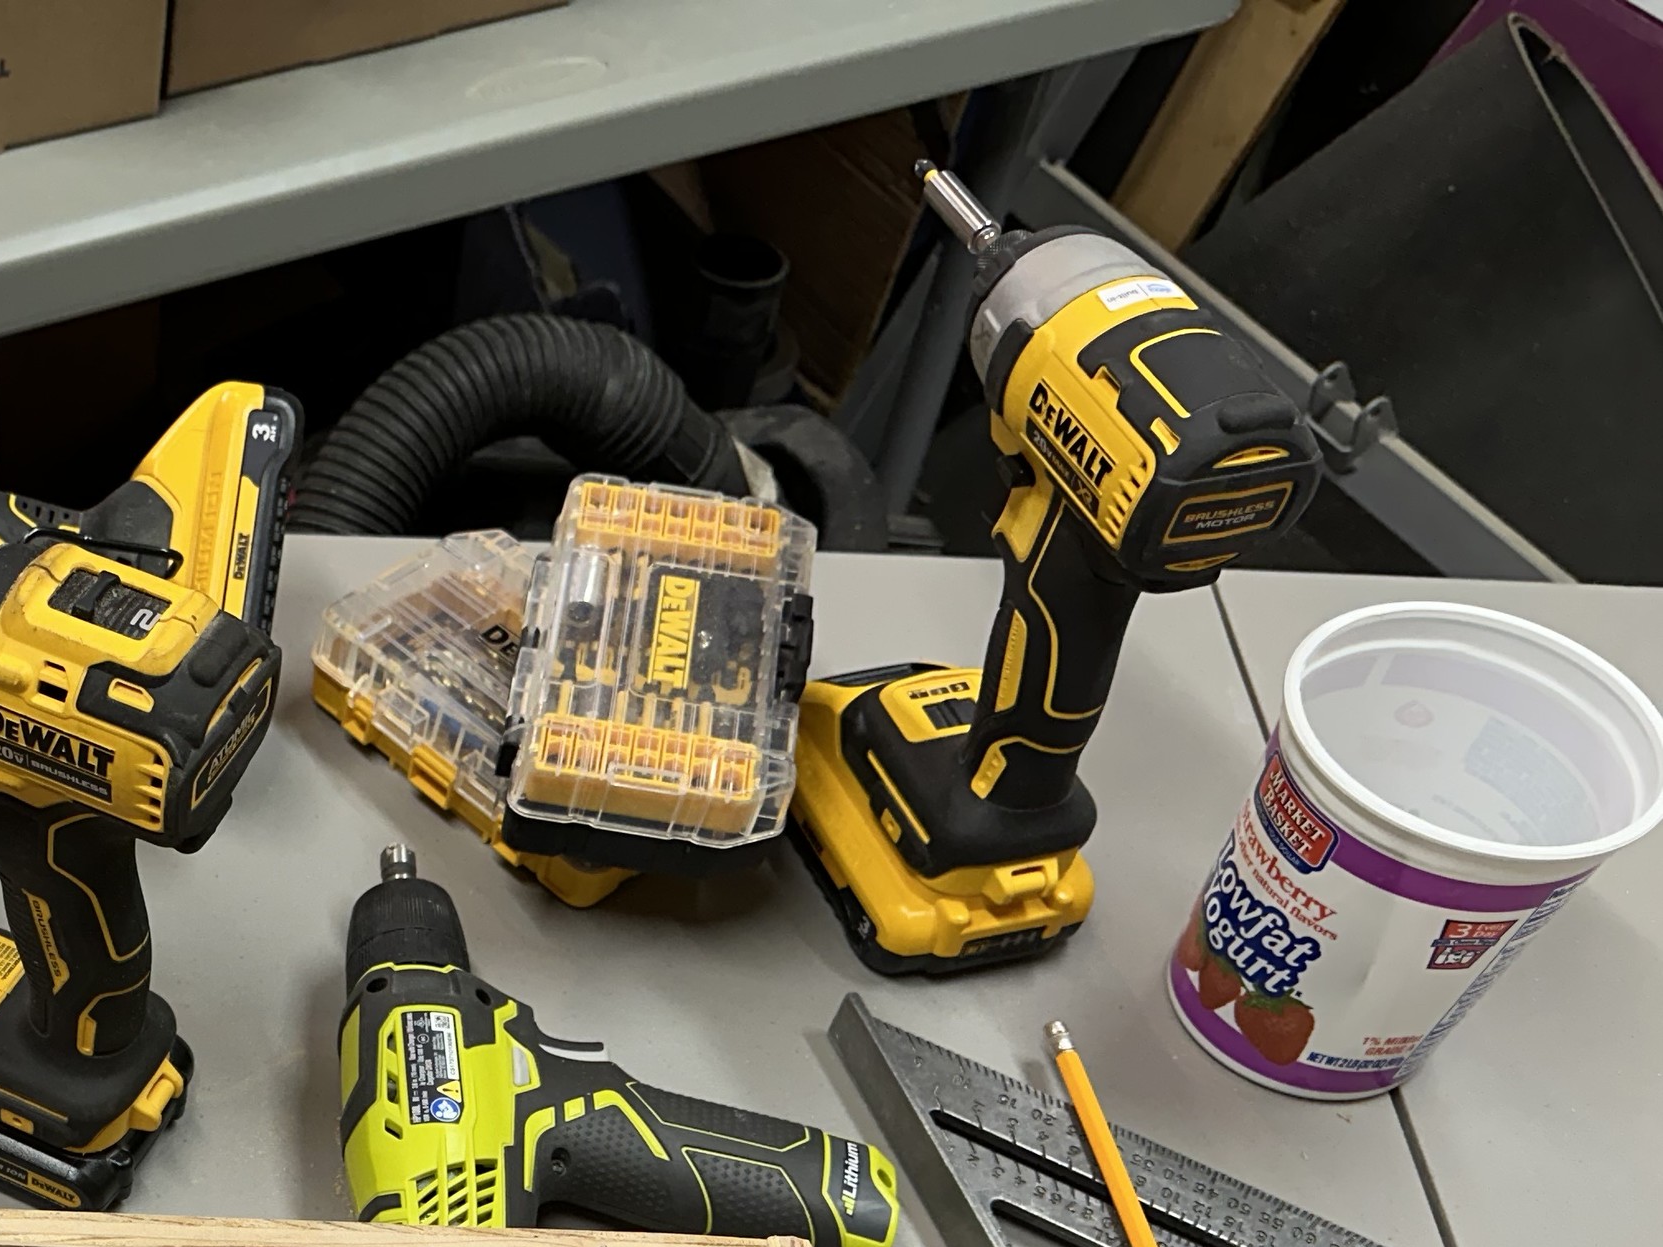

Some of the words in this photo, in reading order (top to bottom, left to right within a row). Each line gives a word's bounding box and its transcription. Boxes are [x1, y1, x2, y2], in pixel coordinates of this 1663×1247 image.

[1029, 382, 1113, 488] DEWALT
[1183, 499, 1276, 524] BRUSHLESS
[1195, 514, 1256, 530] MOTOR
[233, 532, 251, 581] DEWALT
[653, 580, 696, 688] DEWALT
[30, 758, 109, 796] BRUSHLESS
[1263, 783, 1313, 858] BASKET
[1268, 769, 1327, 842] MARKET
[1214, 831, 1314, 968] Lowfat
[1252, 867, 1290, 913] natural
[1289, 906, 1339, 941] flavors
[32, 900, 63, 979] BRUSHLESS
[1449, 923, 1473, 938] 3
[5, 1166, 28, 1181] ION
[845, 1142, 861, 1188] Lithium
[1163, 1167, 1187, 1184] 40
[30, 1176, 77, 1204] DEWALT
[1160, 1186, 1180, 1204] 10
[1193, 1182, 1219, 1200] 45
[1226, 1197, 1253, 1216] 50
[1192, 1200, 1213, 1218] 12
